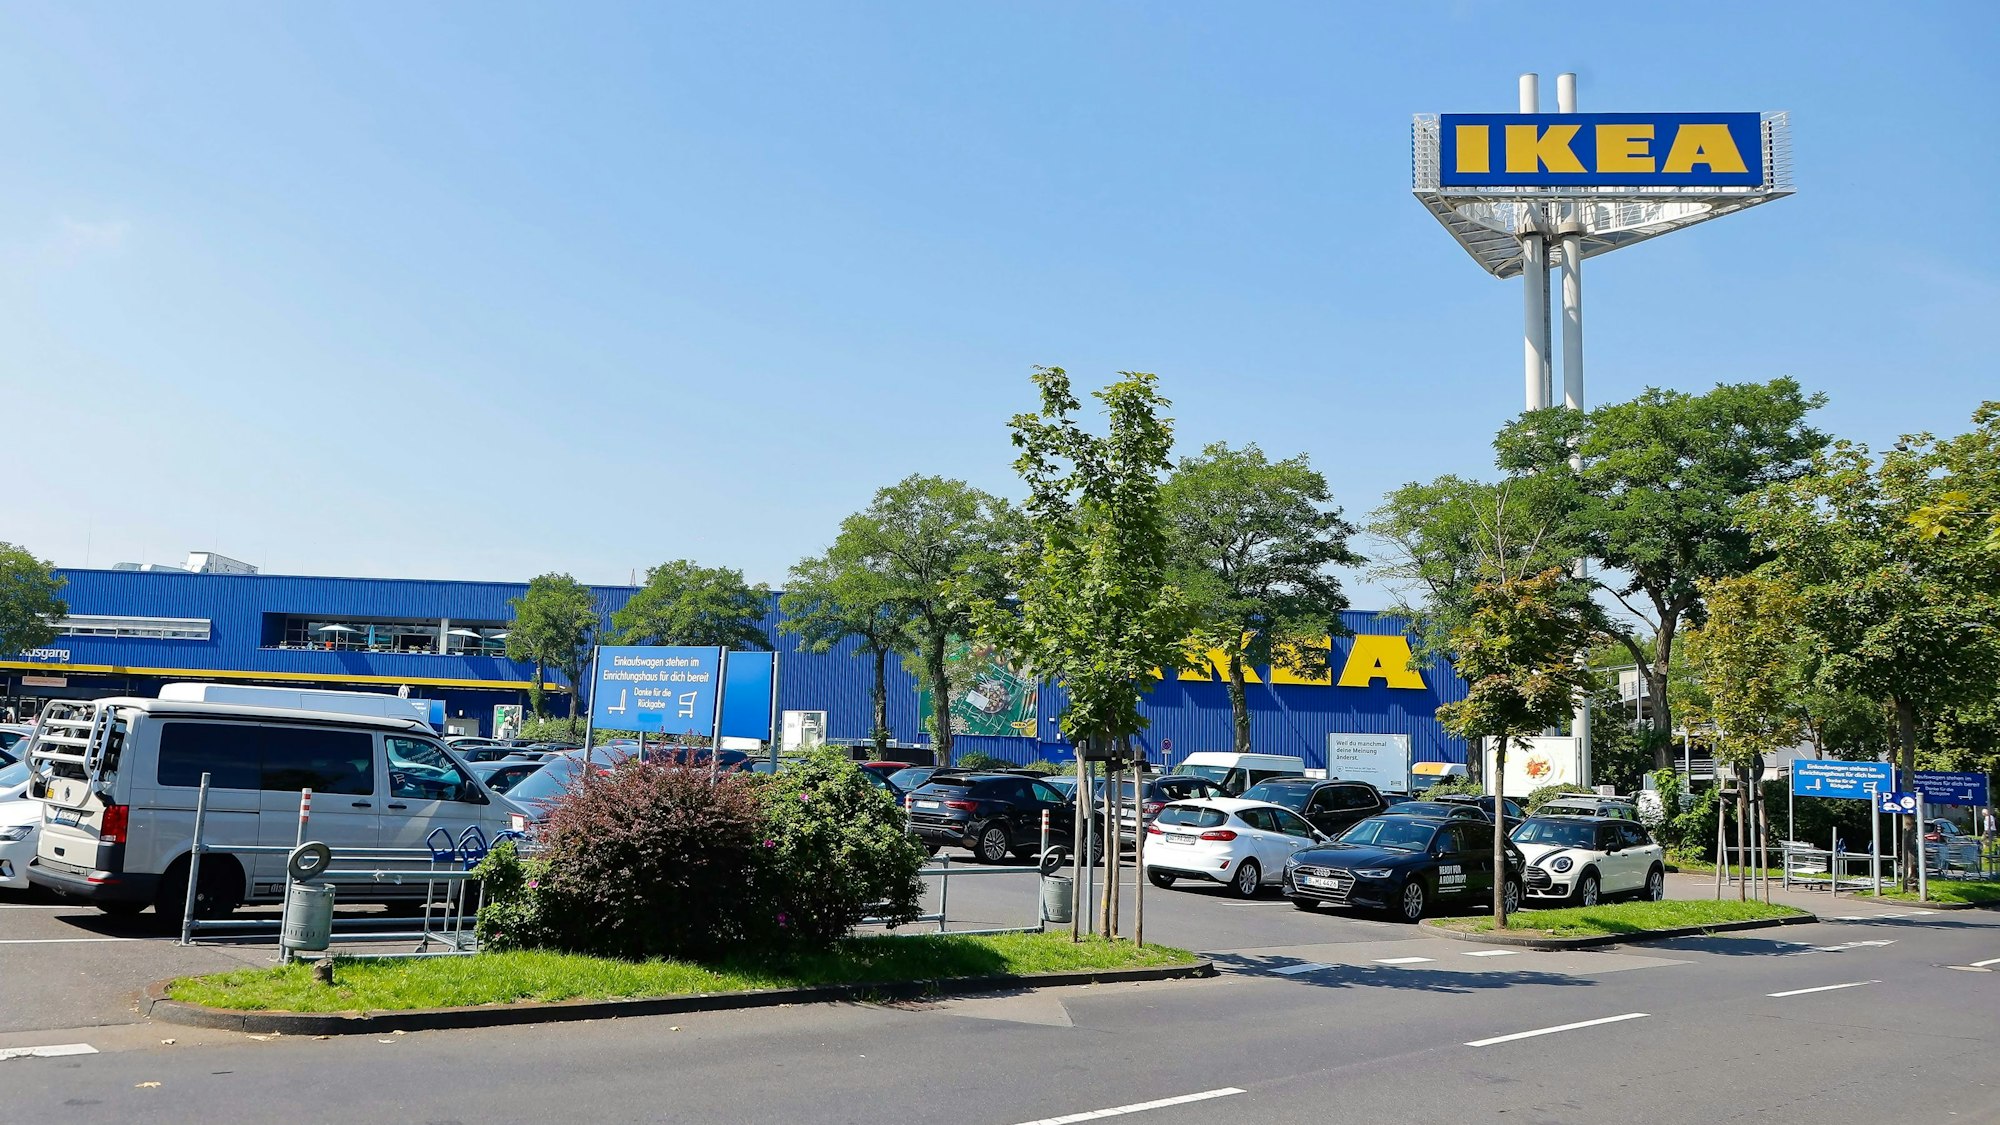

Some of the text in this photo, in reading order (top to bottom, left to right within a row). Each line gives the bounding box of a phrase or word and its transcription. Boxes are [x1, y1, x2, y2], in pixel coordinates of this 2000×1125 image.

[1456, 124, 1749, 173] IKEA
[614, 655, 699, 669] Einkaufswagen stehen im
[1129, 631, 1427, 689] KEA
[603, 670, 709, 683] Einrichtungshaus für dich bereit
[634, 687, 672, 697] Danke für die
[637, 699, 666, 710] Rückgabe
[1798, 769, 1845, 777] Einrichtungshaus
[1807, 763, 1848, 772] Einkaufswagen
[1882, 792, 1892, 802] P
